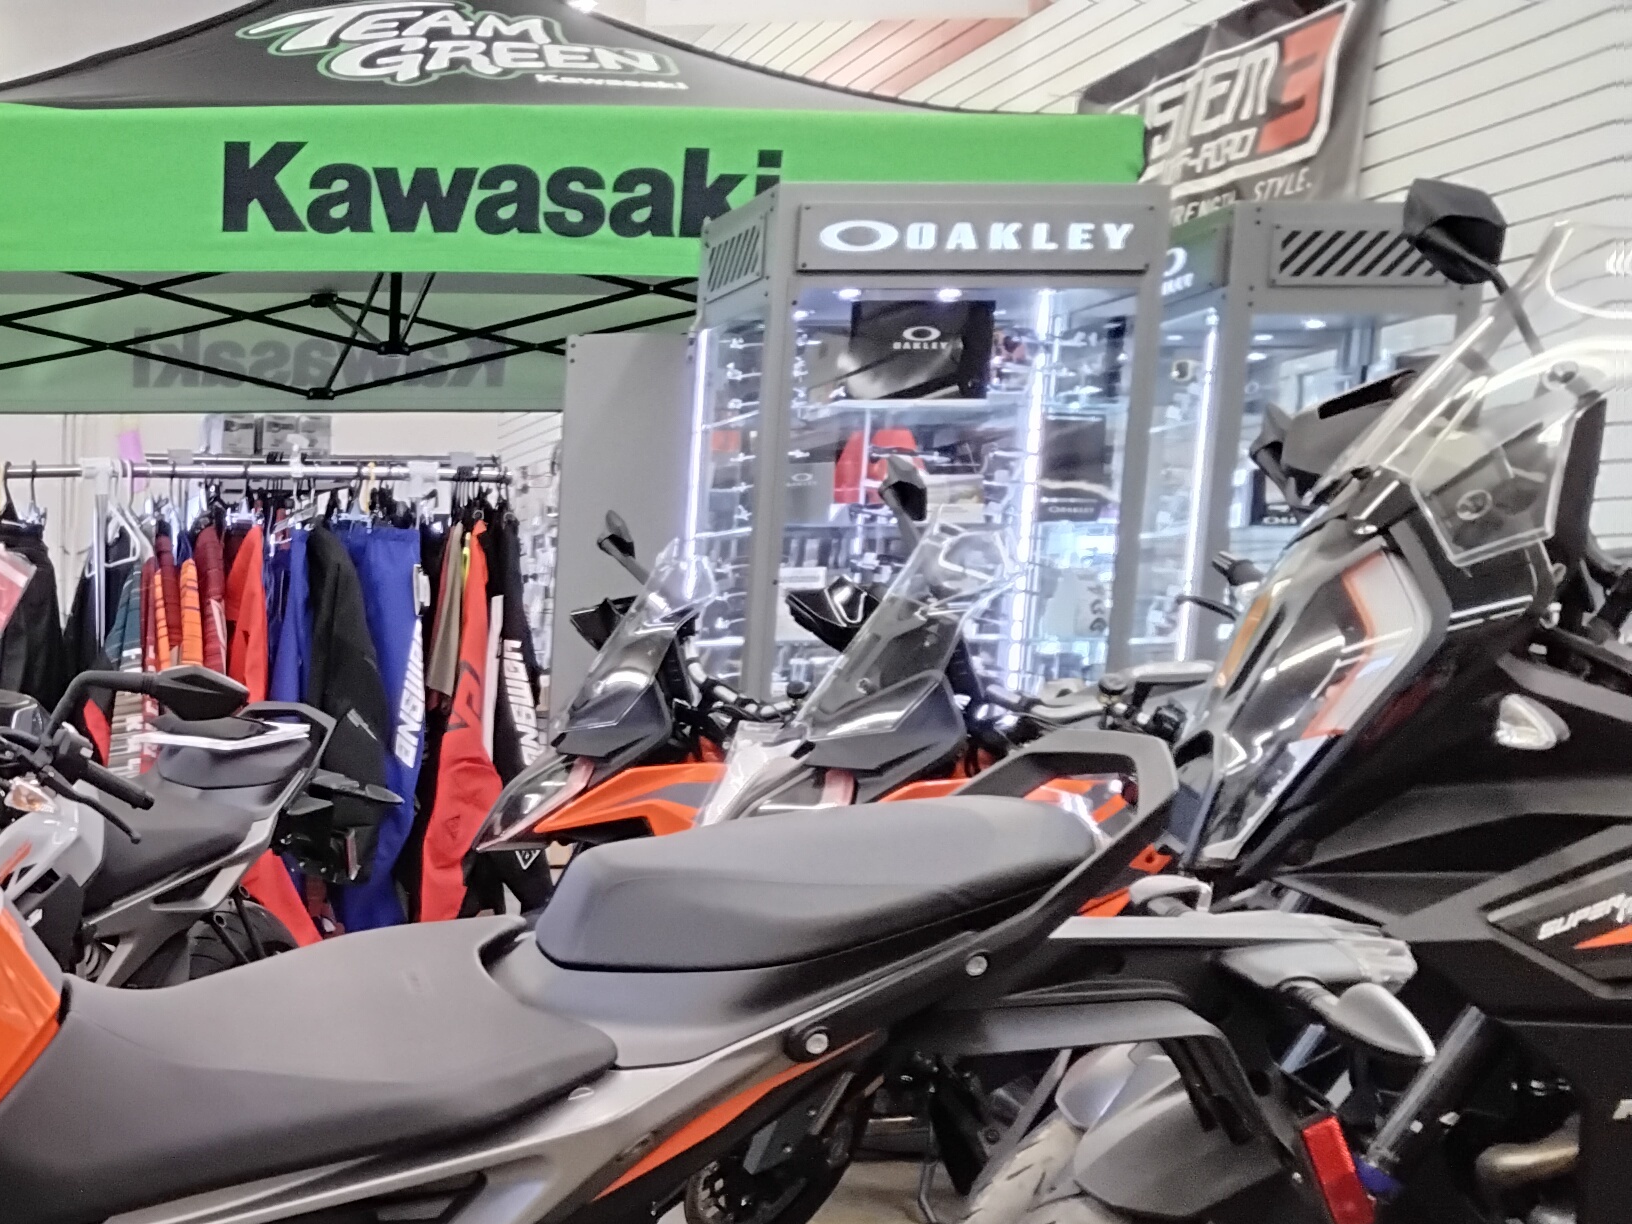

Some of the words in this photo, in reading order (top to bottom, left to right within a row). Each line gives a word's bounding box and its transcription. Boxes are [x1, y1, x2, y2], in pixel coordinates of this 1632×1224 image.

[248, 2, 552, 51] TEAM
[330, 37, 661, 82] GREEN
[1145, 41, 1280, 160] STEM
[1253, 167, 1313, 201] STYLE.
[906, 221, 1135, 251] OAKLEY
[892, 341, 949, 350] OAKLEY
